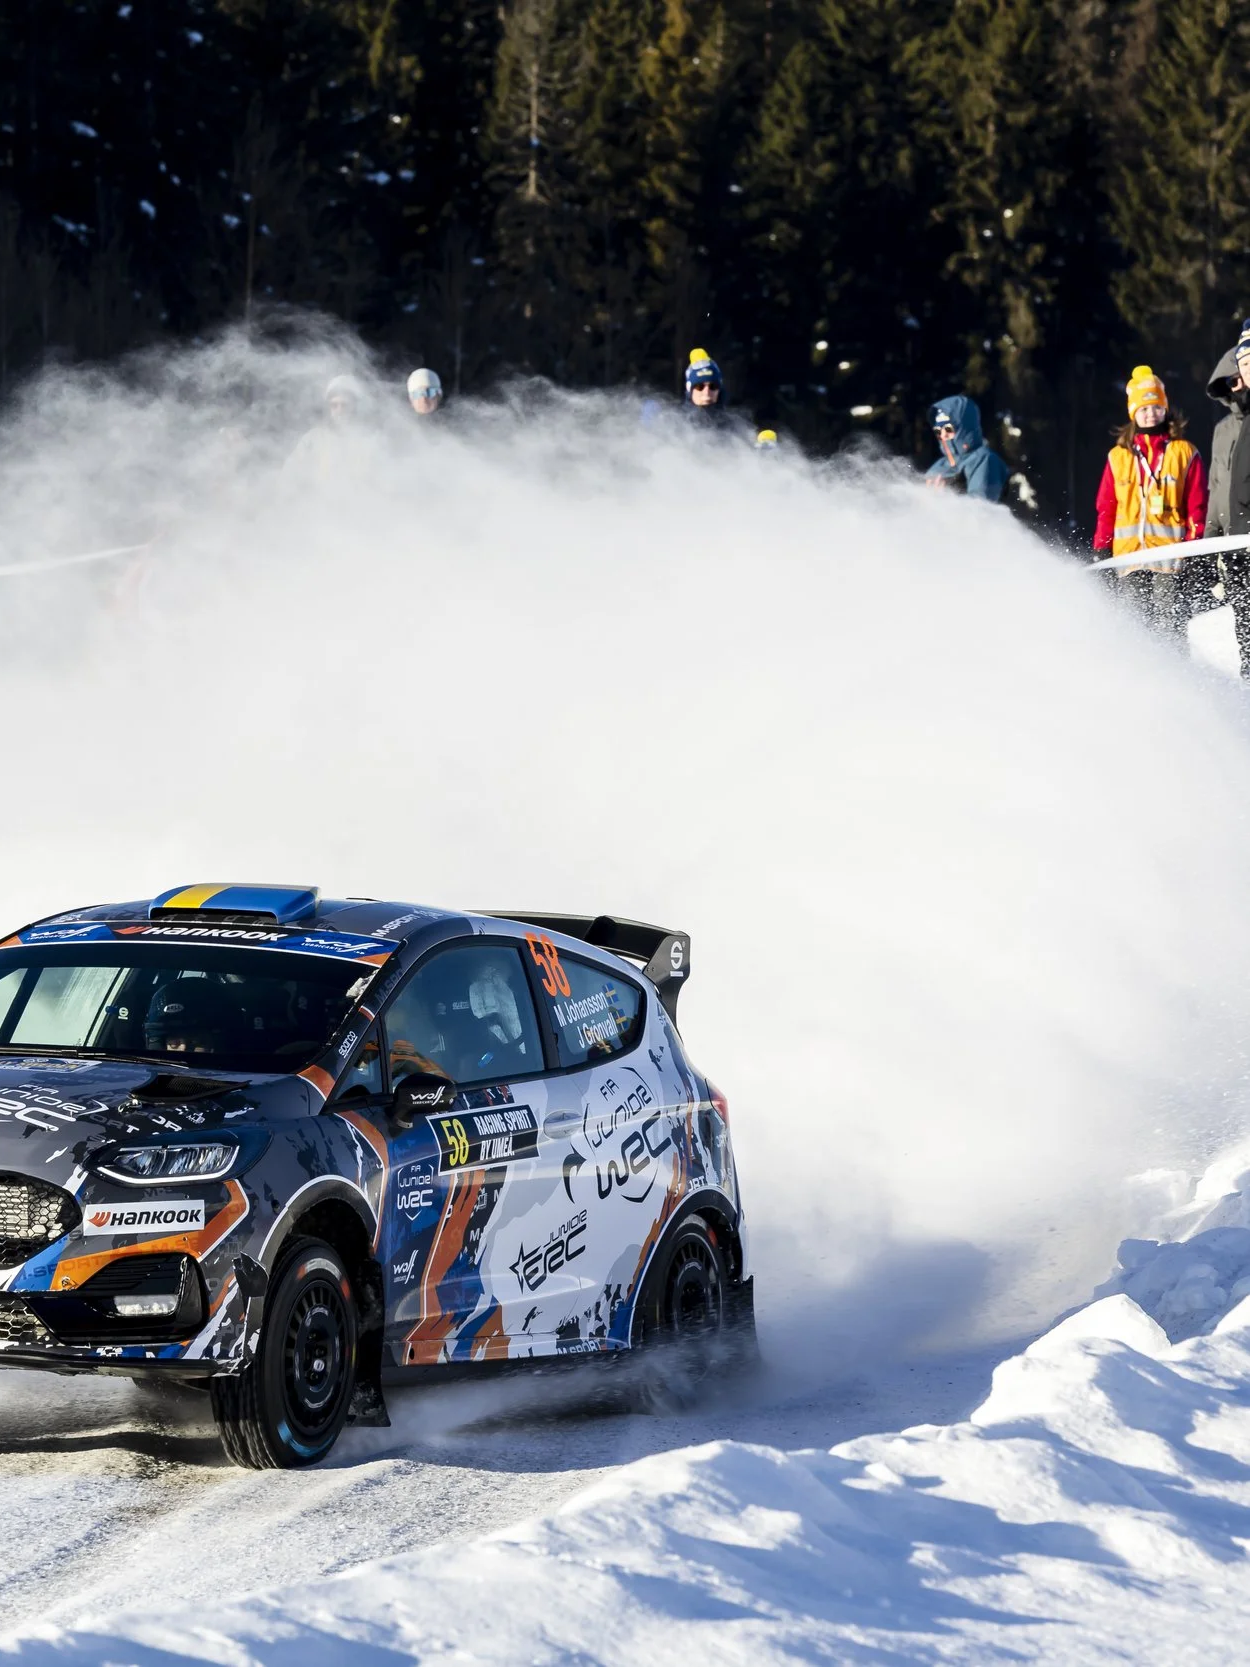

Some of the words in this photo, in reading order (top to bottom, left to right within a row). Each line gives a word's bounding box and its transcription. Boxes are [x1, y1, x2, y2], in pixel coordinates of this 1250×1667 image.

[524, 931, 571, 998] 58
[553, 1005, 567, 1027] M
[564, 991, 609, 1023] Johansson
[576, 1026, 586, 1049] J
[583, 1012, 619, 1046] Grönvall
[19, 1084, 60, 1095] FIA
[410, 1085, 446, 1106] wolf
[600, 1078, 619, 1101] FIA
[473, 1114, 507, 1136] RACING
[505, 1109, 533, 1131] SPIRIT
[591, 1084, 652, 1148] JUNIOR
[440, 1118, 469, 1166] 58
[480, 1140, 493, 1160] BY
[595, 1110, 672, 1200] WRC
[399, 1174, 431, 1188] JUNIOR
[410, 1164, 421, 1173] FIA
[397, 1189, 434, 1210] WRC
[544, 1209, 588, 1248] JUNIOR
[393, 1250, 419, 1284] wolf
[523, 1223, 587, 1292] ERC
